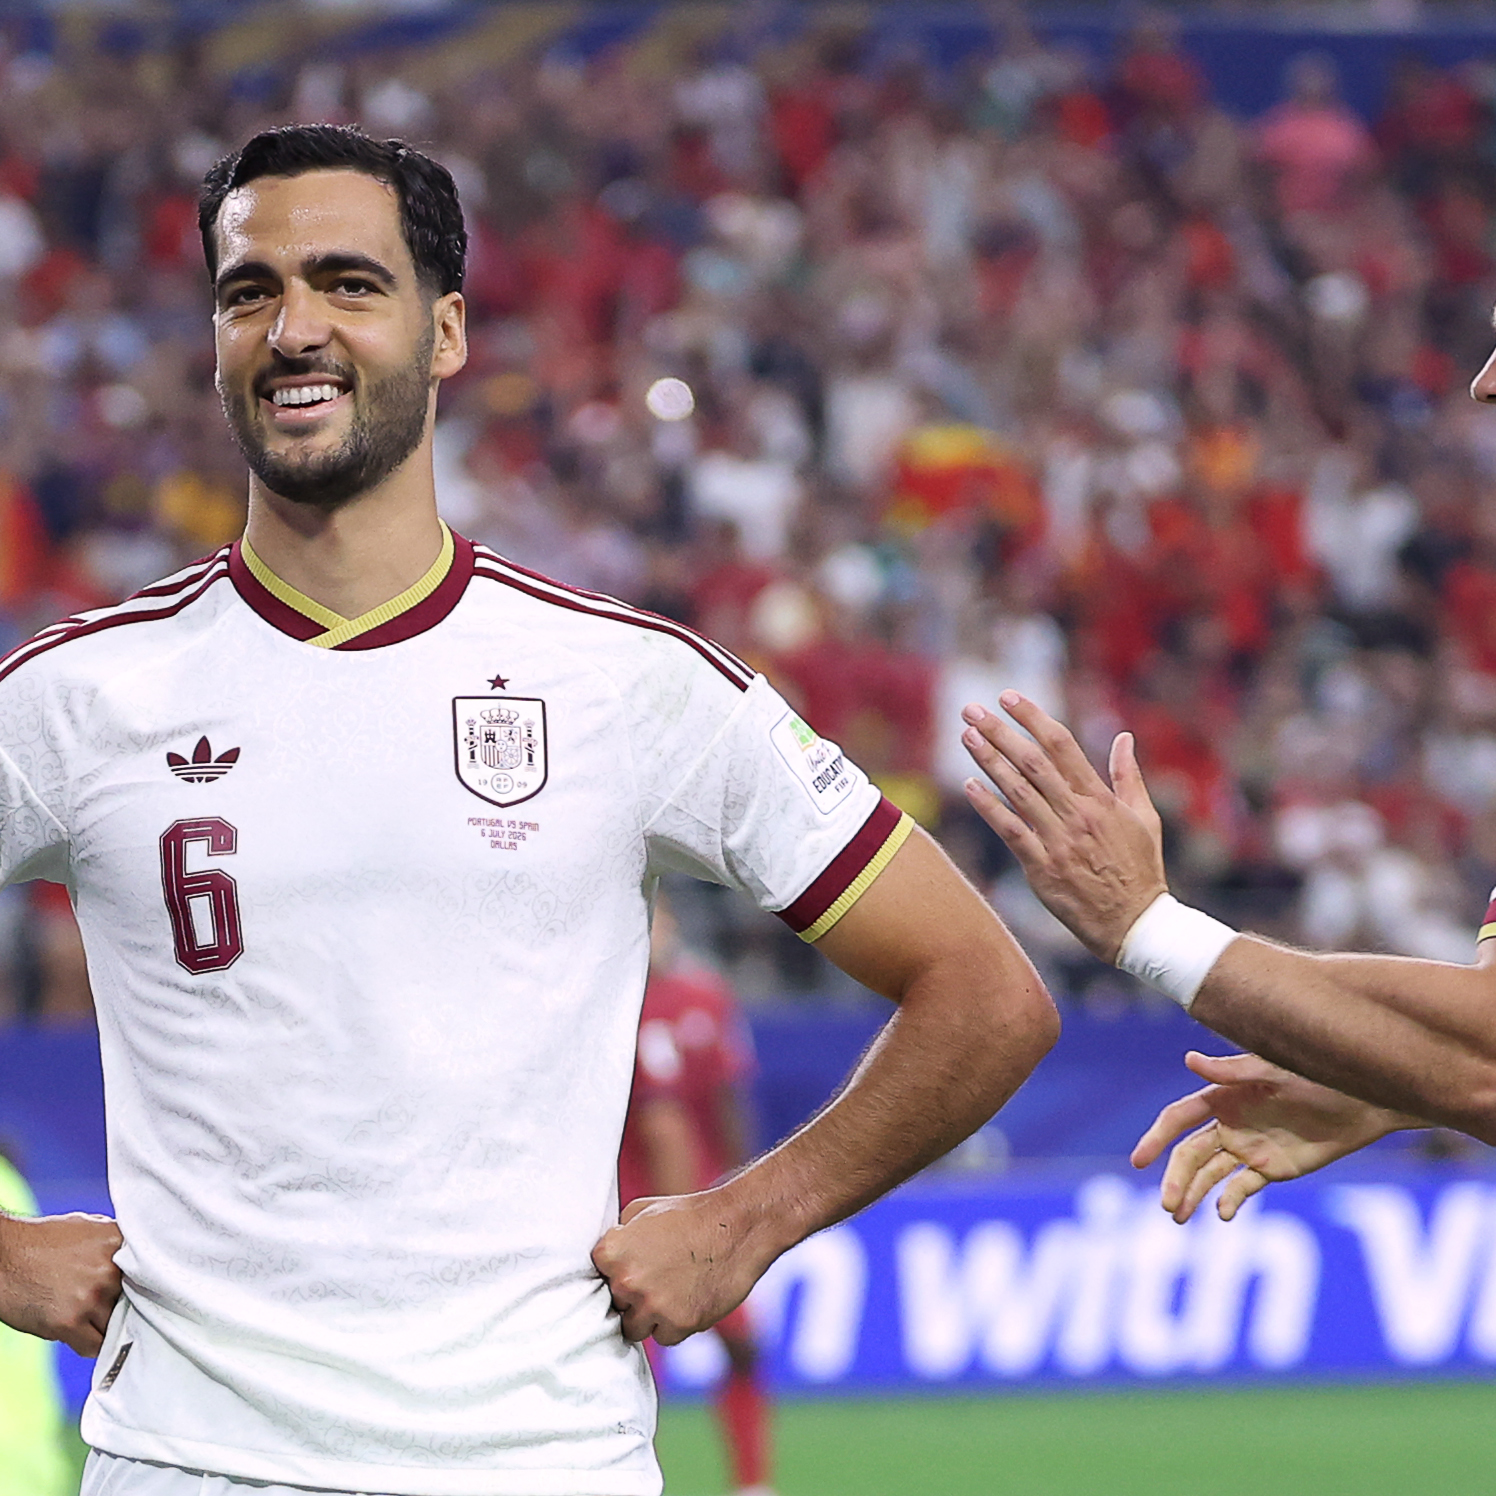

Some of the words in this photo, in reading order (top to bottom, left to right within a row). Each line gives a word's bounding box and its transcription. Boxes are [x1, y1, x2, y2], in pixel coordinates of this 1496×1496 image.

[467, 817, 505, 828] PORTUGAL
[507, 819, 516, 829] VS
[519, 821, 539, 832] SPAIN
[488, 828, 505, 839] JULY
[508, 831, 527, 842] 2026
[490, 839, 518, 851] DALLAS
[159, 816, 245, 976] 6
[894, 1172, 1322, 1382] with
